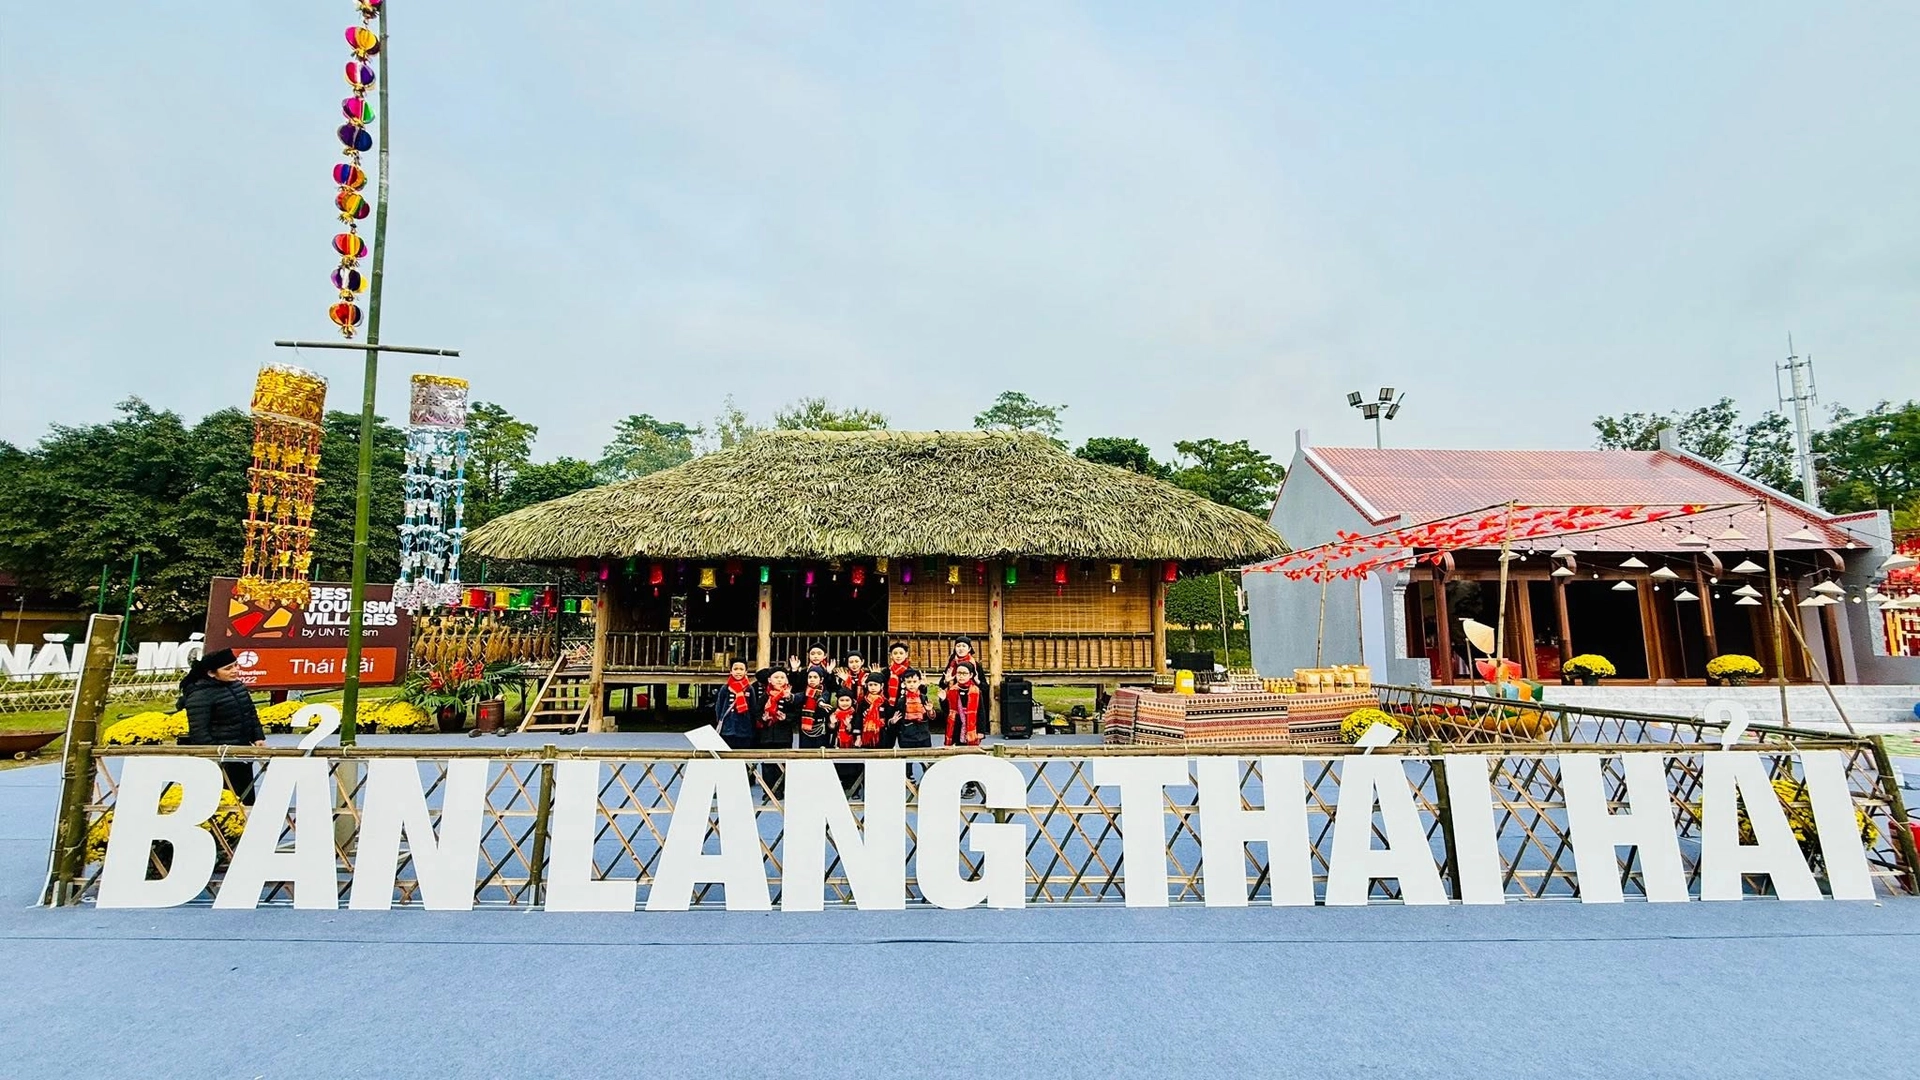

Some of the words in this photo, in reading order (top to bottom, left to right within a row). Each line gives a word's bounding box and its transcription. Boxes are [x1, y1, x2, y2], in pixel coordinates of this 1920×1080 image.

[301, 628, 316, 639] by
[318, 628, 335, 637] UN
[338, 628, 379, 637] Tosm
[289, 657, 335, 674] Thái
[96, 703, 490, 911] BẢN
[544, 725, 1026, 912] LÀNG
[1093, 722, 1505, 908] THÁI
[1558, 700, 1877, 904] HẢI
